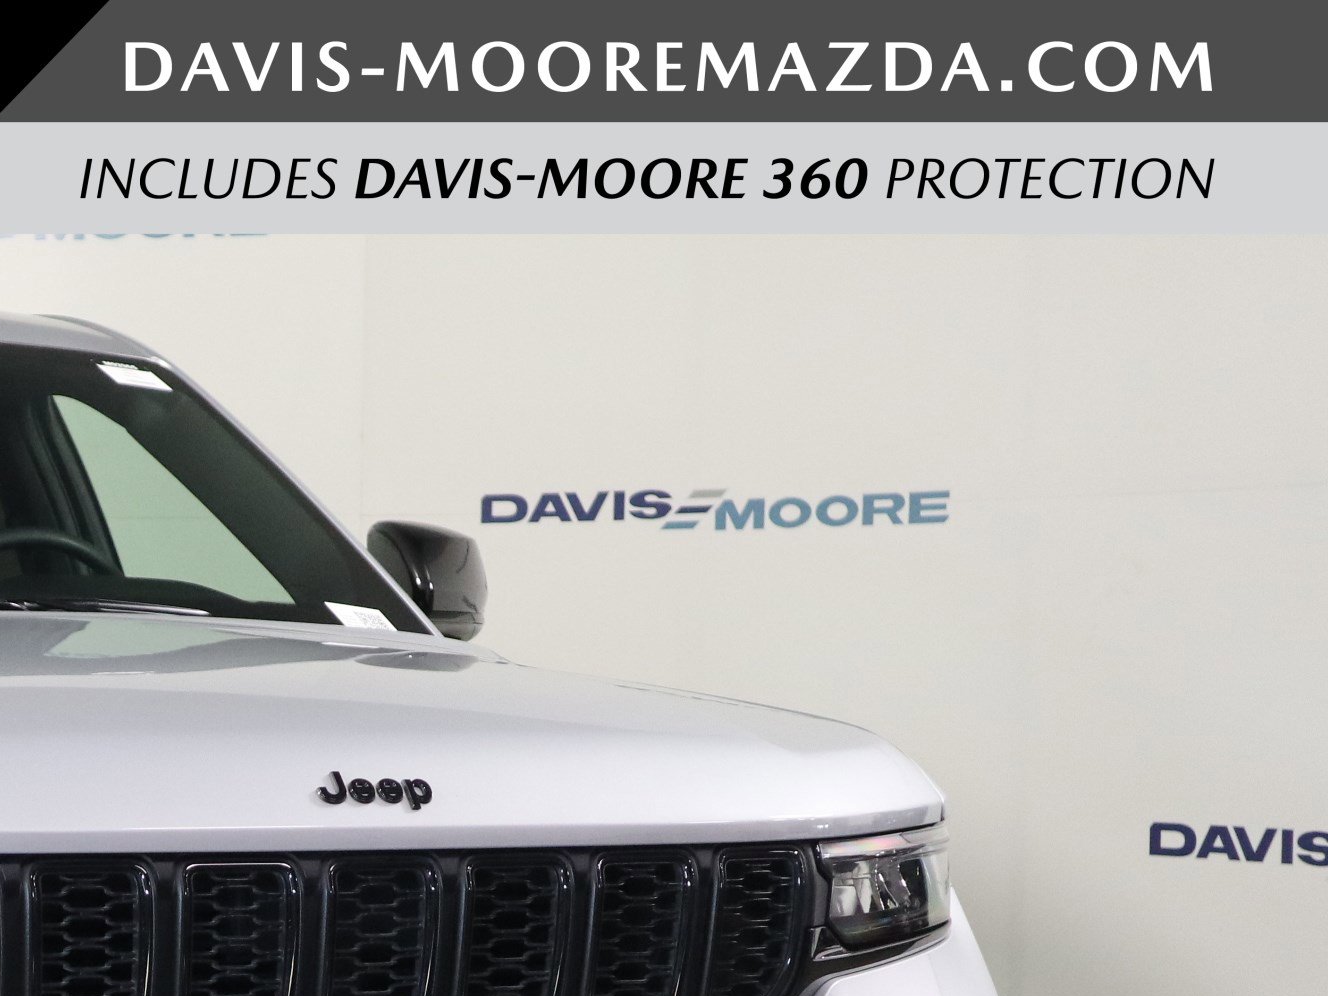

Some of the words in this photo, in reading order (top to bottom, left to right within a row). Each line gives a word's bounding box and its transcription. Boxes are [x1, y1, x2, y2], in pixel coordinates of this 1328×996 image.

[481, 489, 671, 525] DAVIS
[715, 490, 951, 531] MOORE
[316, 771, 433, 811] Jeep
